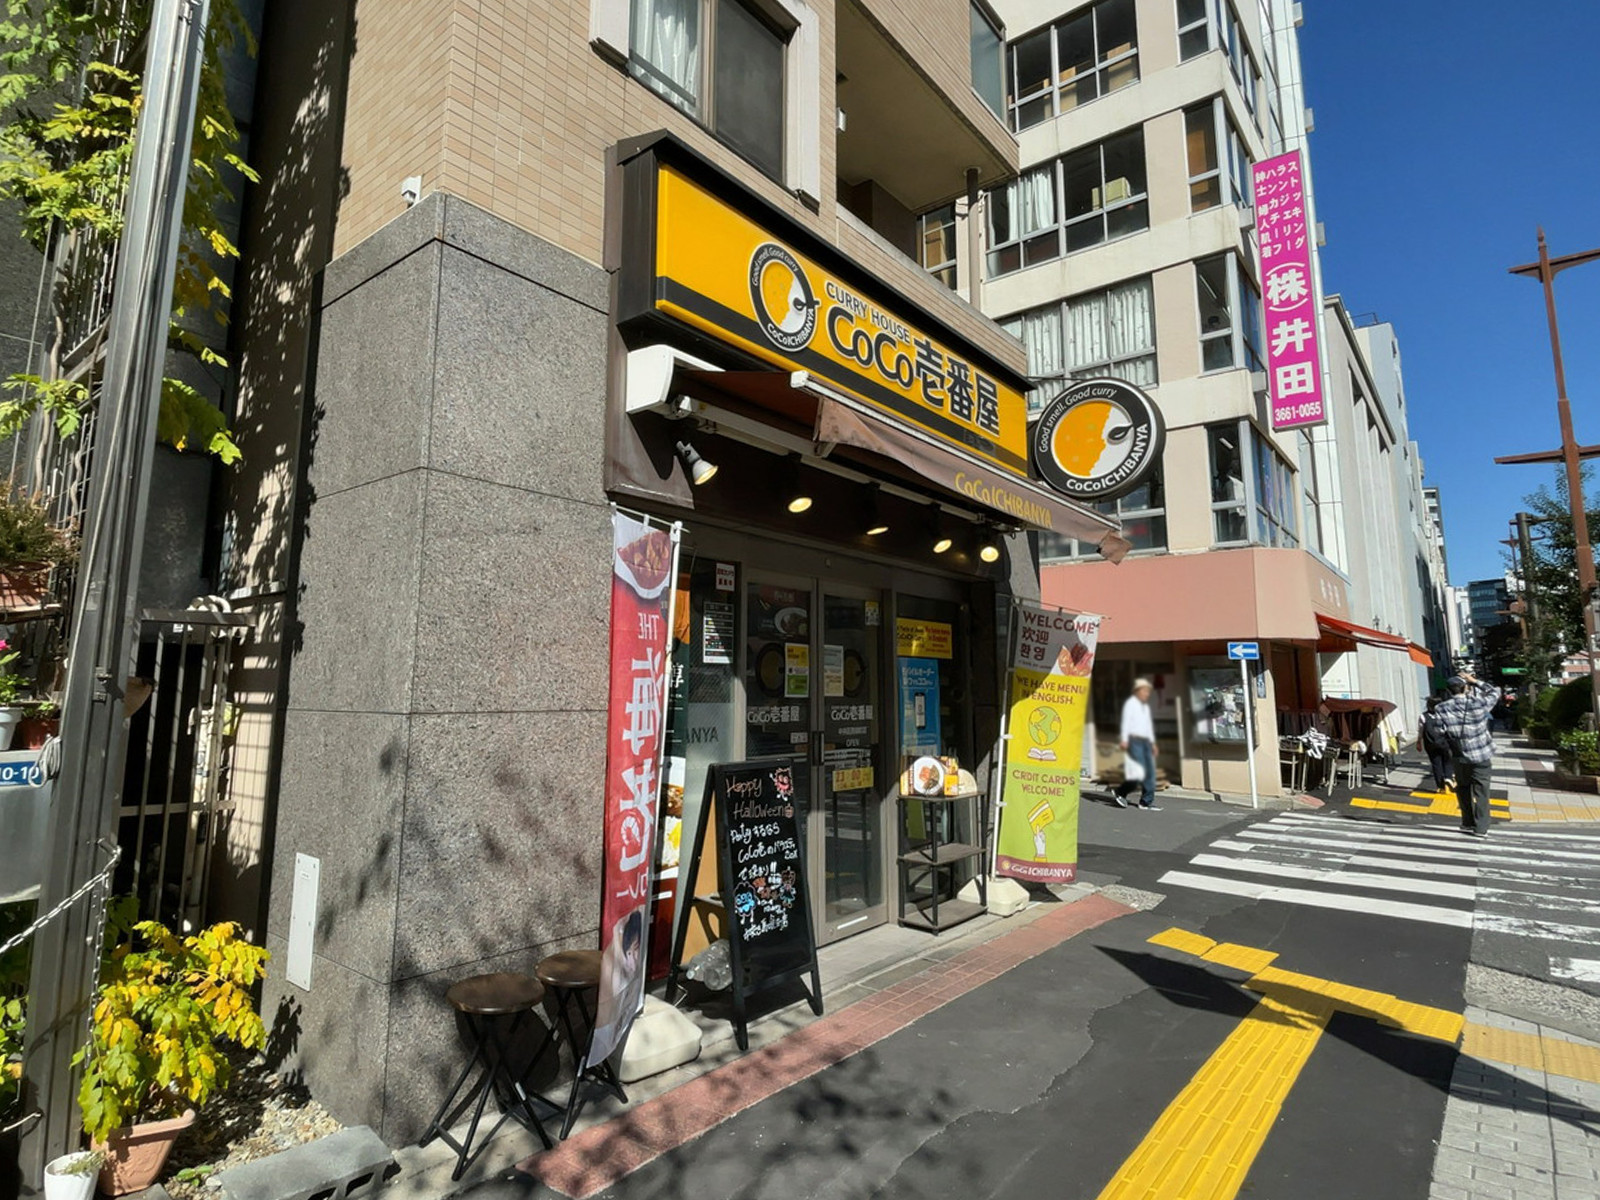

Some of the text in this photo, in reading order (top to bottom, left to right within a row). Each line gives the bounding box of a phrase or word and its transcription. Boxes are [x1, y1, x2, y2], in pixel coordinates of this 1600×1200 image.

[1266, 169, 1282, 255] ハンカチーフ
[1276, 164, 1292, 251] ランジェリー
[1287, 161, 1306, 249] ストッキング
[825, 281, 911, 345] CURRY HOUSE
[827, 306, 1001, 438] CoCo壱番屋
[1038, 387, 1118, 453] Good smell. Good curry
[1274, 401, 1321, 421] 3661-0055
[1066, 423, 1149, 491] CoCoICHIBANYA
[1022, 610, 1096, 635] WELCOME
[1022, 626, 1049, 645] 欢迎
[1030, 678, 1056, 692] HAVE
[726, 776, 762, 798] Happy
[1041, 773, 1075, 786] CARDS
[733, 800, 785, 820] Halloween
